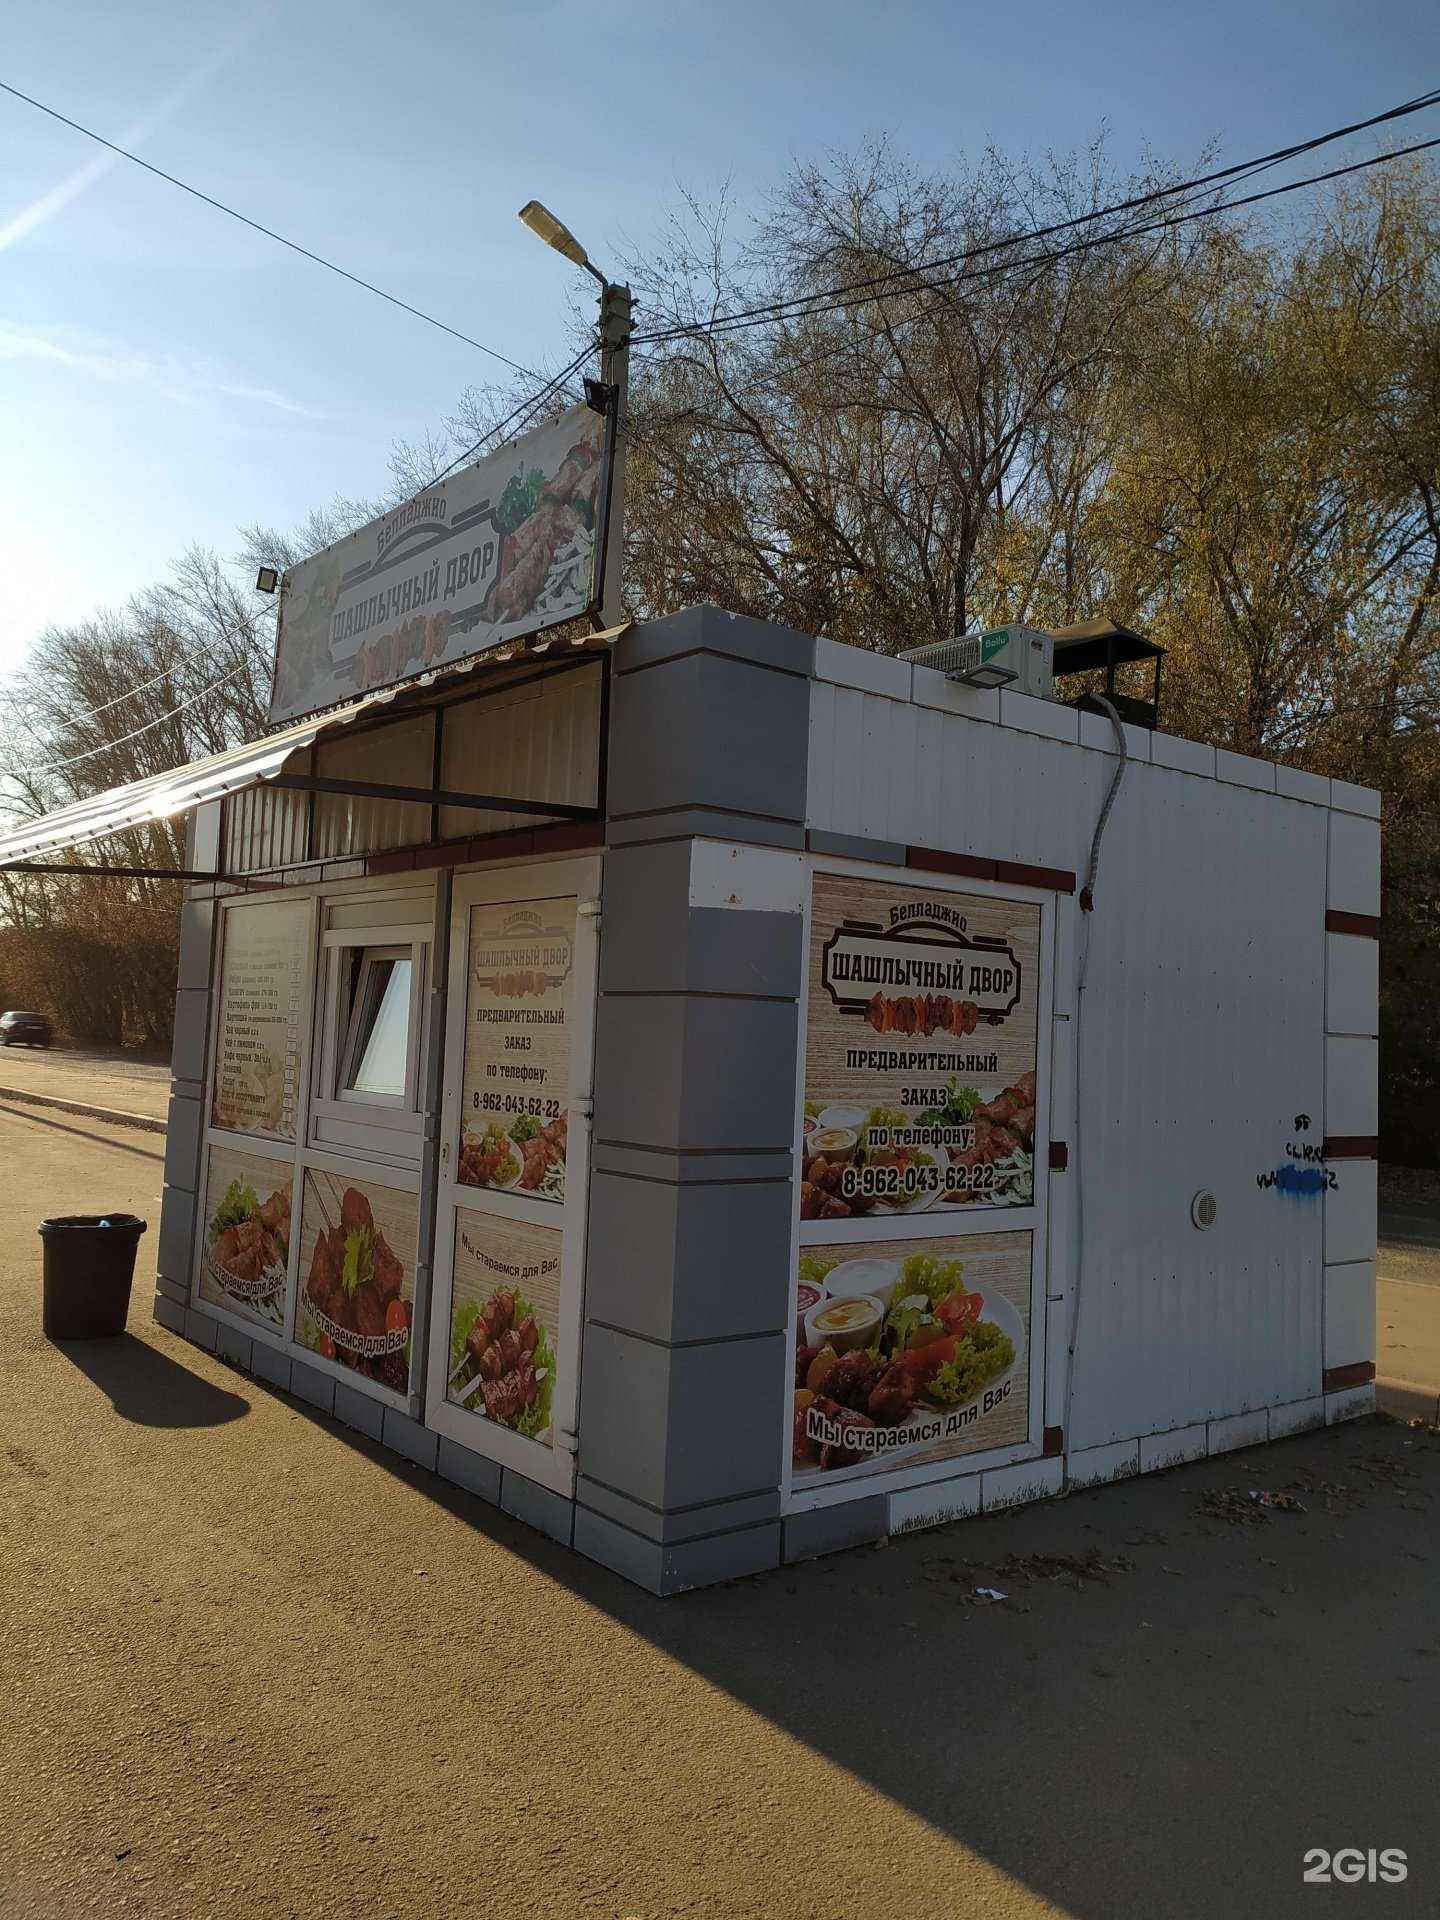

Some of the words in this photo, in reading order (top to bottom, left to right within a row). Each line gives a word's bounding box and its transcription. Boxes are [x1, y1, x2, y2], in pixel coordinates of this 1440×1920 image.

[376, 496, 448, 551] Белладжио
[331, 556, 440, 645] ШАШЛЫЧНЫЙ
[443, 540, 495, 602] ДВОР
[889, 902, 968, 933] Белладжио
[477, 945, 540, 968] ШАШЛЫЧНЫЙ
[542, 947, 568, 969] ДВОР
[831, 952, 964, 991] ШАШЛЫЧНЫЙ
[968, 966, 1013, 996] ДВОР
[476, 1007, 565, 1025] ПРЕДВАРИТЕЛЬНЫЙ
[504, 1035, 531, 1050] ЗАКАЗ
[486, 1064, 497, 1077] по
[500, 1063, 548, 1083] телефону:
[846, 1049, 998, 1073] ПРЕДВАРИТЕЛЬНЫЙ
[473, 1090, 560, 1118] 8-962-043-62-22
[901, 1088, 947, 1107] ЗАКАЗ
[869, 1128, 888, 1146] по
[893, 1126, 976, 1149] телефону:
[842, 1165, 995, 1196] 8-962-043-62-22
[461, 1231, 474, 1256] Мы
[475, 1247, 520, 1276] стараемся
[520, 1264, 540, 1280] для
[541, 1256, 558, 1274] Вас
[215, 1263, 250, 1295] стараемся
[250, 1281, 267, 1296] для
[268, 1274, 283, 1292] Вас
[316, 1310, 365, 1353] стараемся
[365, 1337, 386, 1357] для
[387, 1328, 408, 1352] Вас
[808, 1411, 839, 1443] Мы
[846, 1421, 941, 1452] стараемся
[946, 1405, 979, 1437] для
[983, 1380, 1012, 1414] Вас
